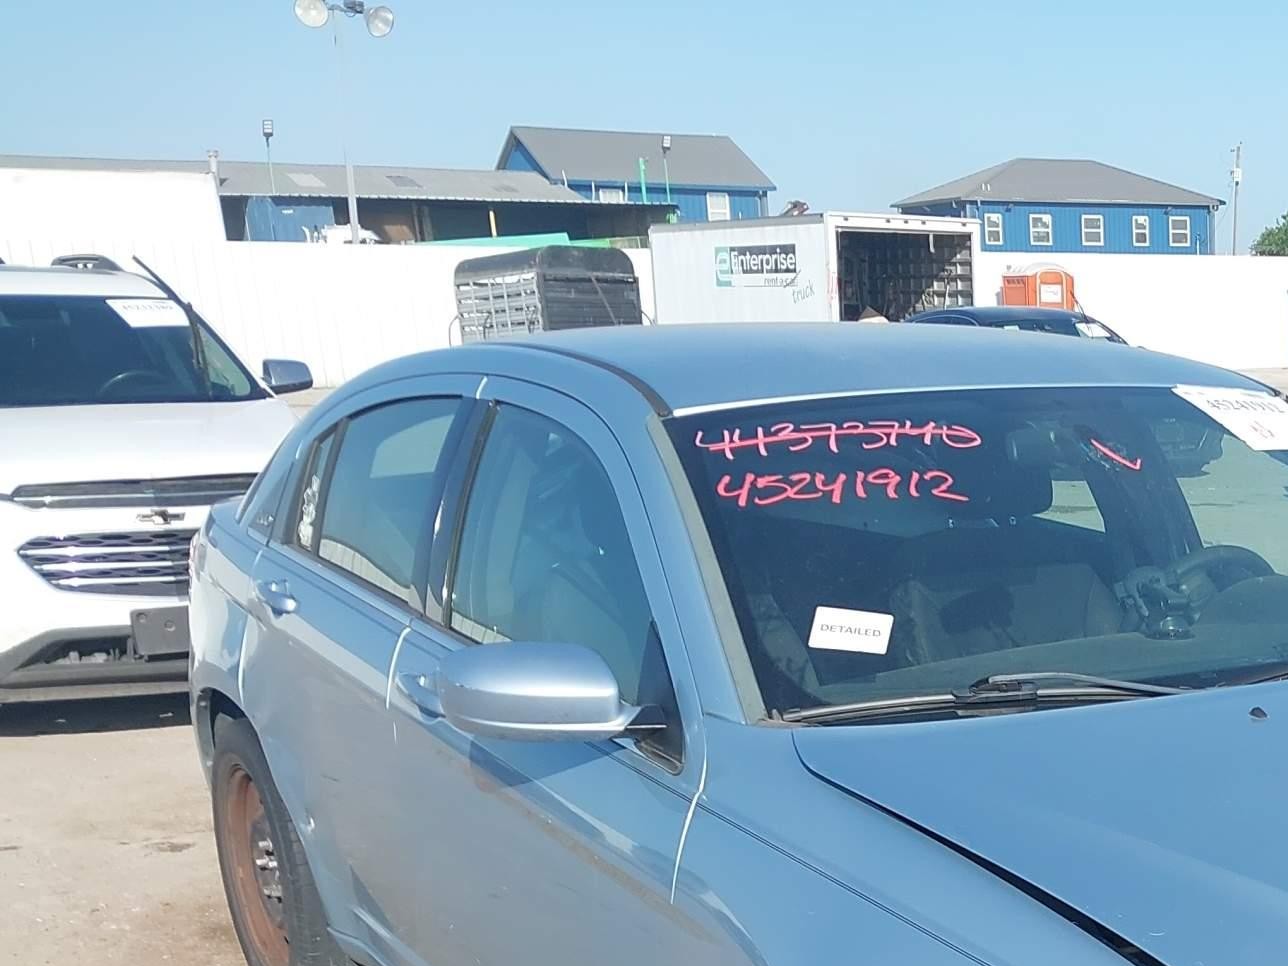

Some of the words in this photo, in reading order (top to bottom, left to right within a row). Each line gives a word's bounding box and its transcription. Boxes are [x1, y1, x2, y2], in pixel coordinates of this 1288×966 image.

[730, 247, 796, 274] Enterprise
[792, 279, 815, 304] truck
[716, 468, 969, 507] 45241912
[820, 623, 881, 637] DETAILED
